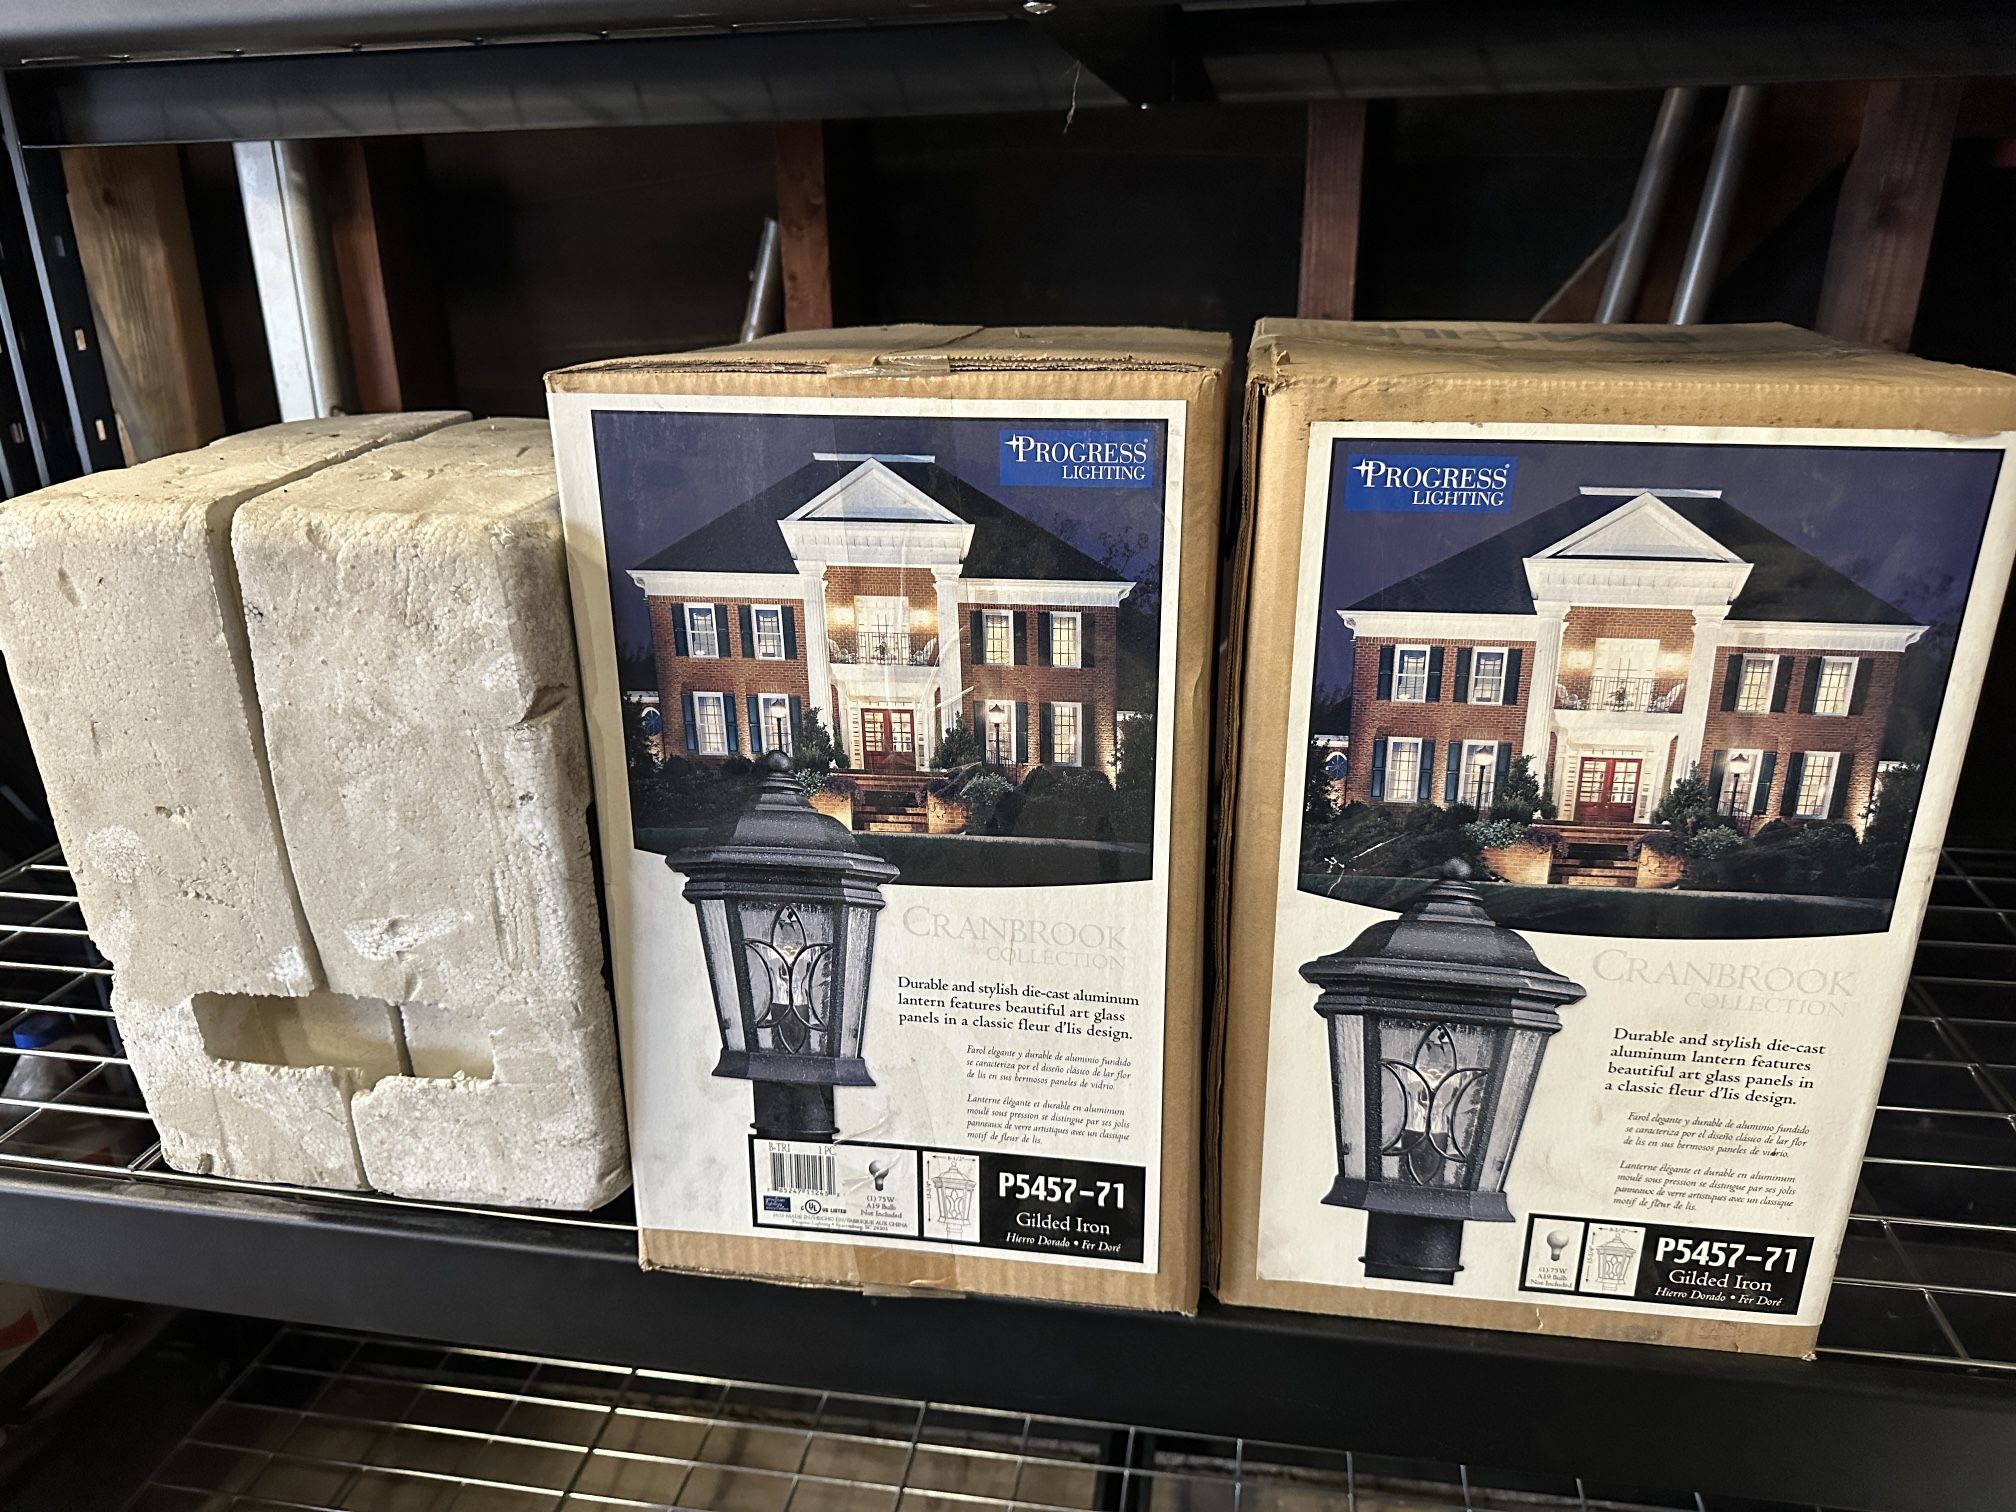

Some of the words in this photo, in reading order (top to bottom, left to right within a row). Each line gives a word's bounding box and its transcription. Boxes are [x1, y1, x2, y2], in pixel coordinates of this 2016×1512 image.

[1015, 435, 1147, 464] PROGRESS
[1061, 465, 1146, 480] LIGHTING
[1363, 460, 1508, 490] PROGRESS
[1411, 490, 1504, 507] LIGHTING
[902, 905, 1128, 950] CRANBROOK
[986, 945, 1126, 970] COLLECTION
[1592, 949, 1854, 997] CRANBROOK
[898, 976, 949, 990] Durable
[952, 980, 975, 992] and
[978, 983, 1018, 998] stylish
[1022, 985, 1070, 1000] die-cast
[1073, 989, 1139, 1006] aluminum
[898, 993, 946, 1008] lantern
[950, 996, 1001, 1011] features
[1006, 1001, 1065, 1016] beautiful
[1070, 1009, 1090, 1018] art
[1094, 1008, 1125, 1023] glass
[1684, 991, 1848, 1018] COLLECTION
[899, 1012, 940, 1025] panels
[944, 1013, 957, 1025] in
[961, 1018, 968, 1026] a
[972, 1016, 1014, 1029] classic
[1018, 1018, 1051, 1032] fleur
[1087, 1024, 1133, 1042] design.
[1614, 1027, 1675, 1043] Durable
[1679, 1034, 1708, 1046] and
[1712, 1036, 1761, 1052] stylish
[1766, 1038, 1827, 1054] die-cast
[966, 1044, 986, 1054] Farol
[1025, 1049, 1052, 1060] durable
[1099, 1056, 1132, 1067] fundido
[1610, 1045, 1686, 1062] aluminum
[1692, 1050, 1746, 1066] lantern
[1752, 1054, 1811, 1070] features
[978, 1070, 986, 1079] lis
[1050, 1078, 1077, 1087] paneles
[1017, 1064, 1030, 1072] por
[1103, 1068, 1114, 1078] lar
[1114, 1070, 1131, 1080] flor
[1608, 1062, 1674, 1078] beautiful
[1678, 1070, 1701, 1080] art
[1704, 1070, 1741, 1085] glass
[1745, 1075, 1794, 1088] panels
[1798, 1076, 1814, 1088] in
[1042, 1100, 1070, 1110] durable
[1604, 1082, 1612, 1090] a
[1618, 1080, 1664, 1094] classic
[1668, 1084, 1705, 1097] fleur
[1745, 1090, 1797, 1108] design.
[1014, 1124, 1032, 1132] verre
[1086, 1118, 1100, 1127] par
[1112, 1119, 1130, 1130] jolis
[1628, 1112, 1650, 1122] Farol
[1692, 1116, 1722, 1128] durable
[1772, 1124, 1810, 1134] fundido
[768, 1142, 790, 1152] B-TRI
[968, 1131, 988, 1142] motif
[998, 1132, 1019, 1143] fleur
[1624, 1136, 1633, 1144] de
[1636, 1136, 1646, 1146] lis
[1716, 1145, 1747, 1155] paneles
[1750, 1146, 1760, 1155] de
[1681, 1130, 1696, 1139] por
[1776, 1136, 1789, 1146] lar
[1786, 1136, 1808, 1148] flor
[825, 1146, 837, 1156] PC
[1704, 1167, 1735, 1178] durable
[999, 1171, 1125, 1209] P5457-71
[1644, 1176, 1662, 1184] sous
[1746, 1186, 1763, 1194] par
[1776, 1186, 1796, 1196] jolis
[1656, 1187, 1666, 1196] de
[1668, 1190, 1686, 1198] verre
[876, 1210, 902, 1218] Included
[1614, 1198, 1638, 1208] motif
[1639, 1198, 1648, 1206] de
[1647, 1198, 1672, 1210] fleur
[1674, 1200, 1682, 1209] de
[1016, 1212, 1070, 1232] Gilded
[1075, 1217, 1111, 1236] Iron
[1006, 1232, 1035, 1244] Hierro
[1038, 1235, 1070, 1248] Dorado
[1082, 1238, 1096, 1251] Fer
[1098, 1241, 1121, 1254] Doré
[1655, 1236, 1798, 1274] P5457-71
[1668, 1269, 1729, 1288] Gilded
[1733, 1274, 1772, 1292] Iron
[1655, 1286, 1688, 1300] Hierro
[1690, 1289, 1726, 1302] Dorado
[1738, 1294, 1754, 1304] Fer
[1757, 1296, 1782, 1307] Doré
